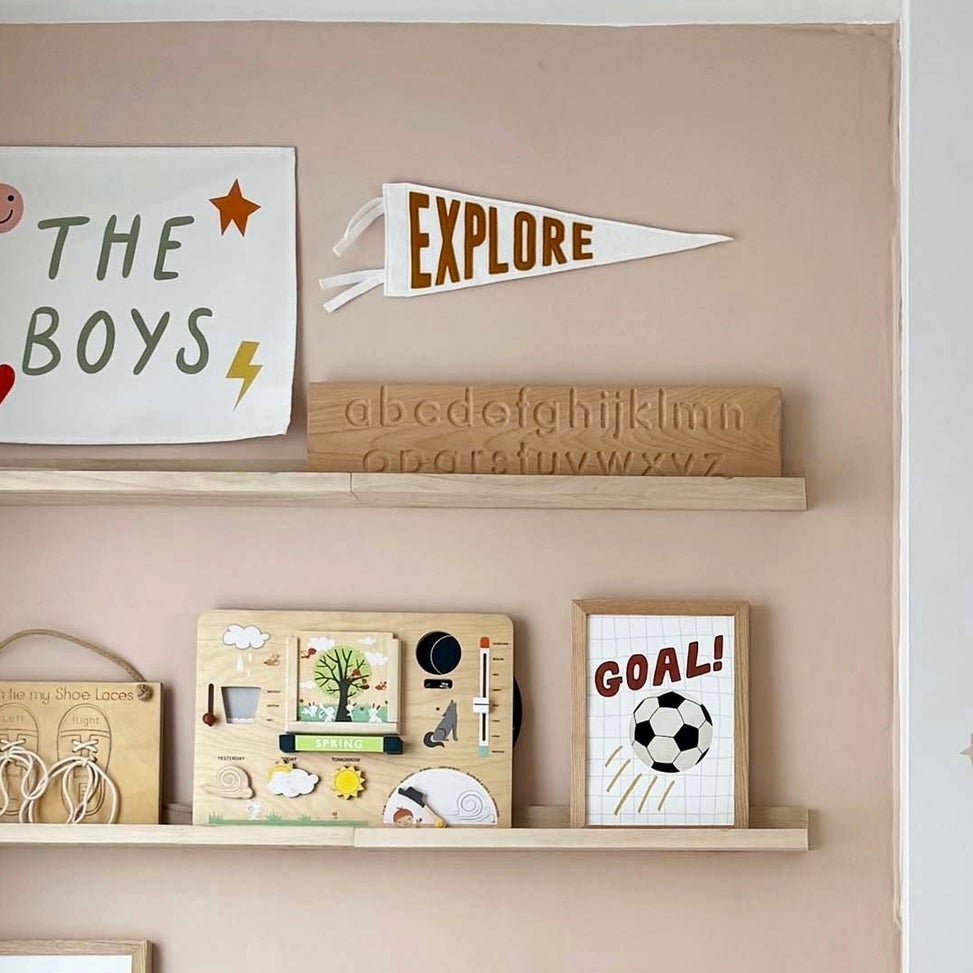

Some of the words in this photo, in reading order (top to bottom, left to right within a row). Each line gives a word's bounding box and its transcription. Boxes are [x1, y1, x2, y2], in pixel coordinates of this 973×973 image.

[38, 215, 195, 282] THE
[409, 192, 593, 290] EXPLORE
[22, 307, 213, 375] BOYS
[345, 385, 744, 437] abcdefghijklmn
[9, 687, 25, 700] tie
[30, 690, 50, 705] my
[55, 686, 91, 701] Shoe
[95, 687, 134, 701] Laces
[595, 635, 724, 697] GOAL!
[315, 738, 364, 749] SPRING
